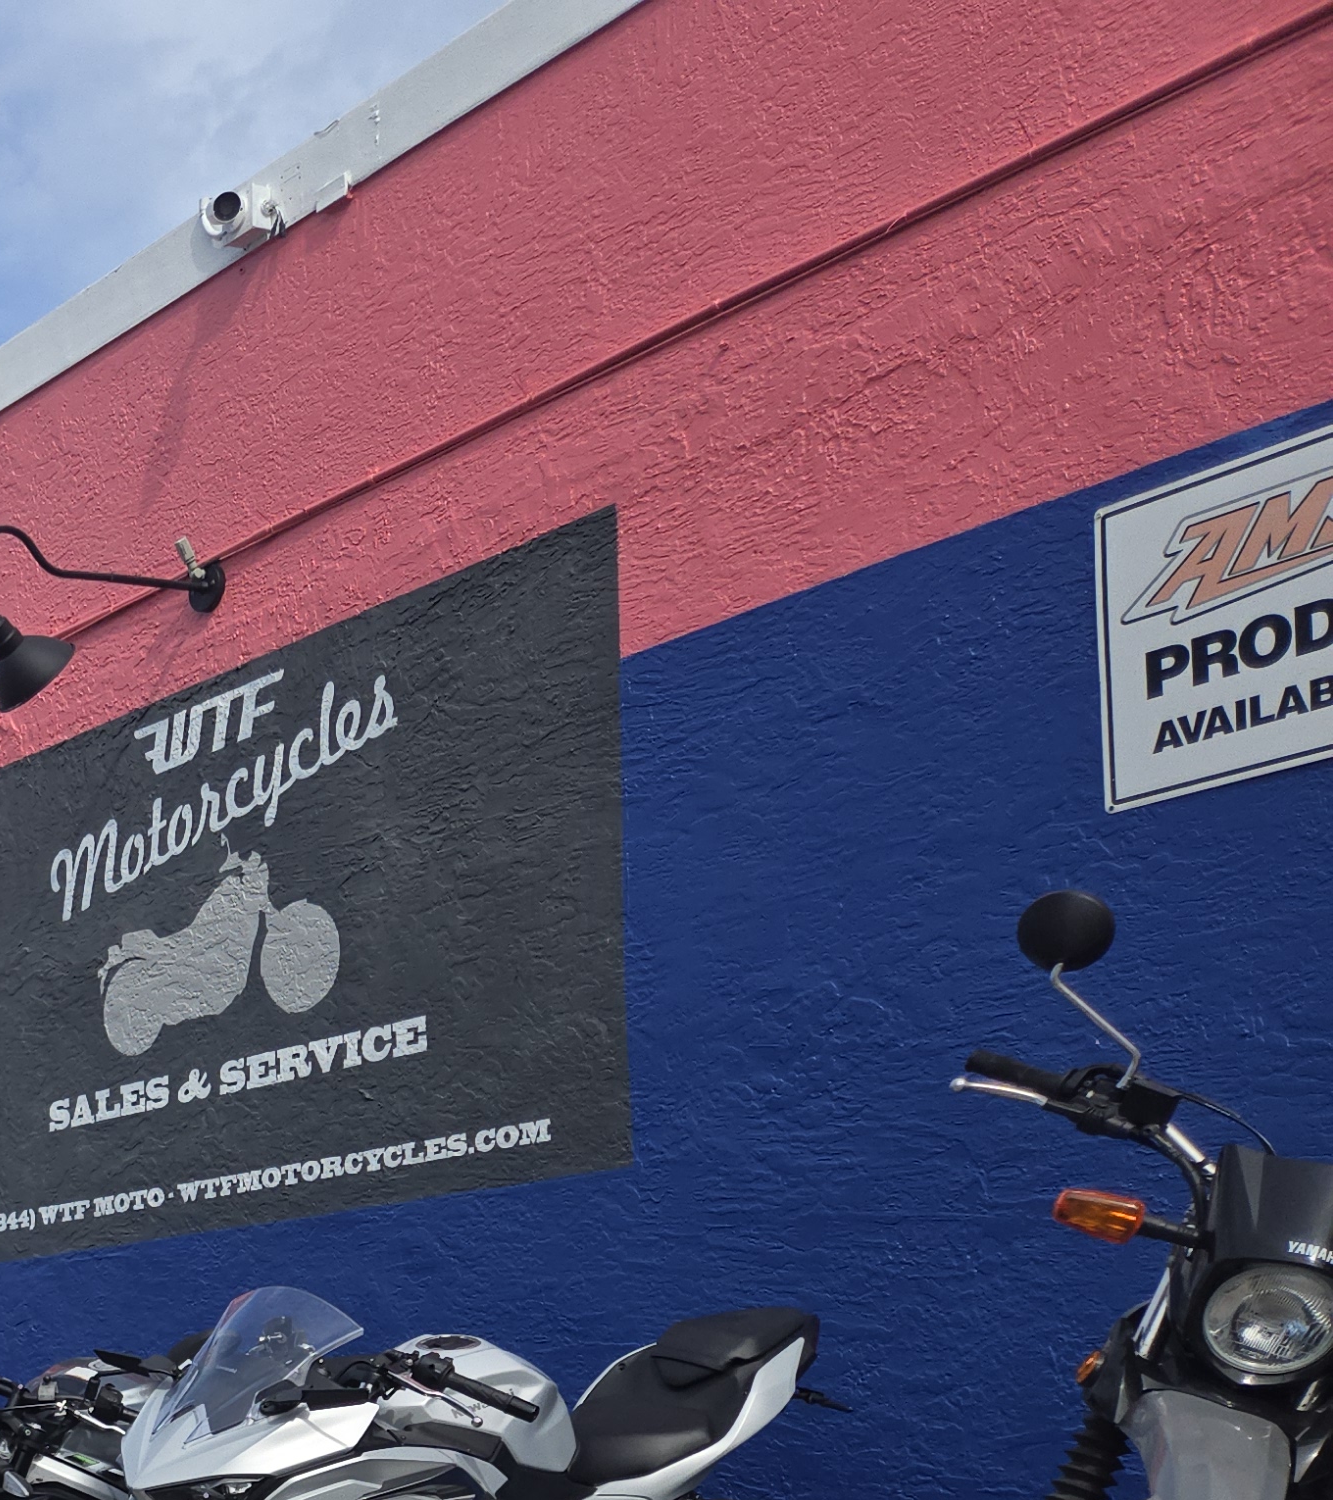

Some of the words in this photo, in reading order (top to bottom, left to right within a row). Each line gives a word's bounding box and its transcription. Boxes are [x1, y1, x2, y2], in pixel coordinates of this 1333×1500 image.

[1144, 475, 1333, 610] AM
[133, 667, 285, 775] WTF
[50, 675, 399, 922] Motorcycles
[48, 1074, 169, 1132] SALES
[177, 1067, 211, 1103] &
[219, 1015, 428, 1096] SERVICE
[38, 1200, 91, 1225] WTF
[93, 1187, 165, 1218] MOTO
[177, 1118, 552, 1203] WTFMOTORCYCLES.COM
